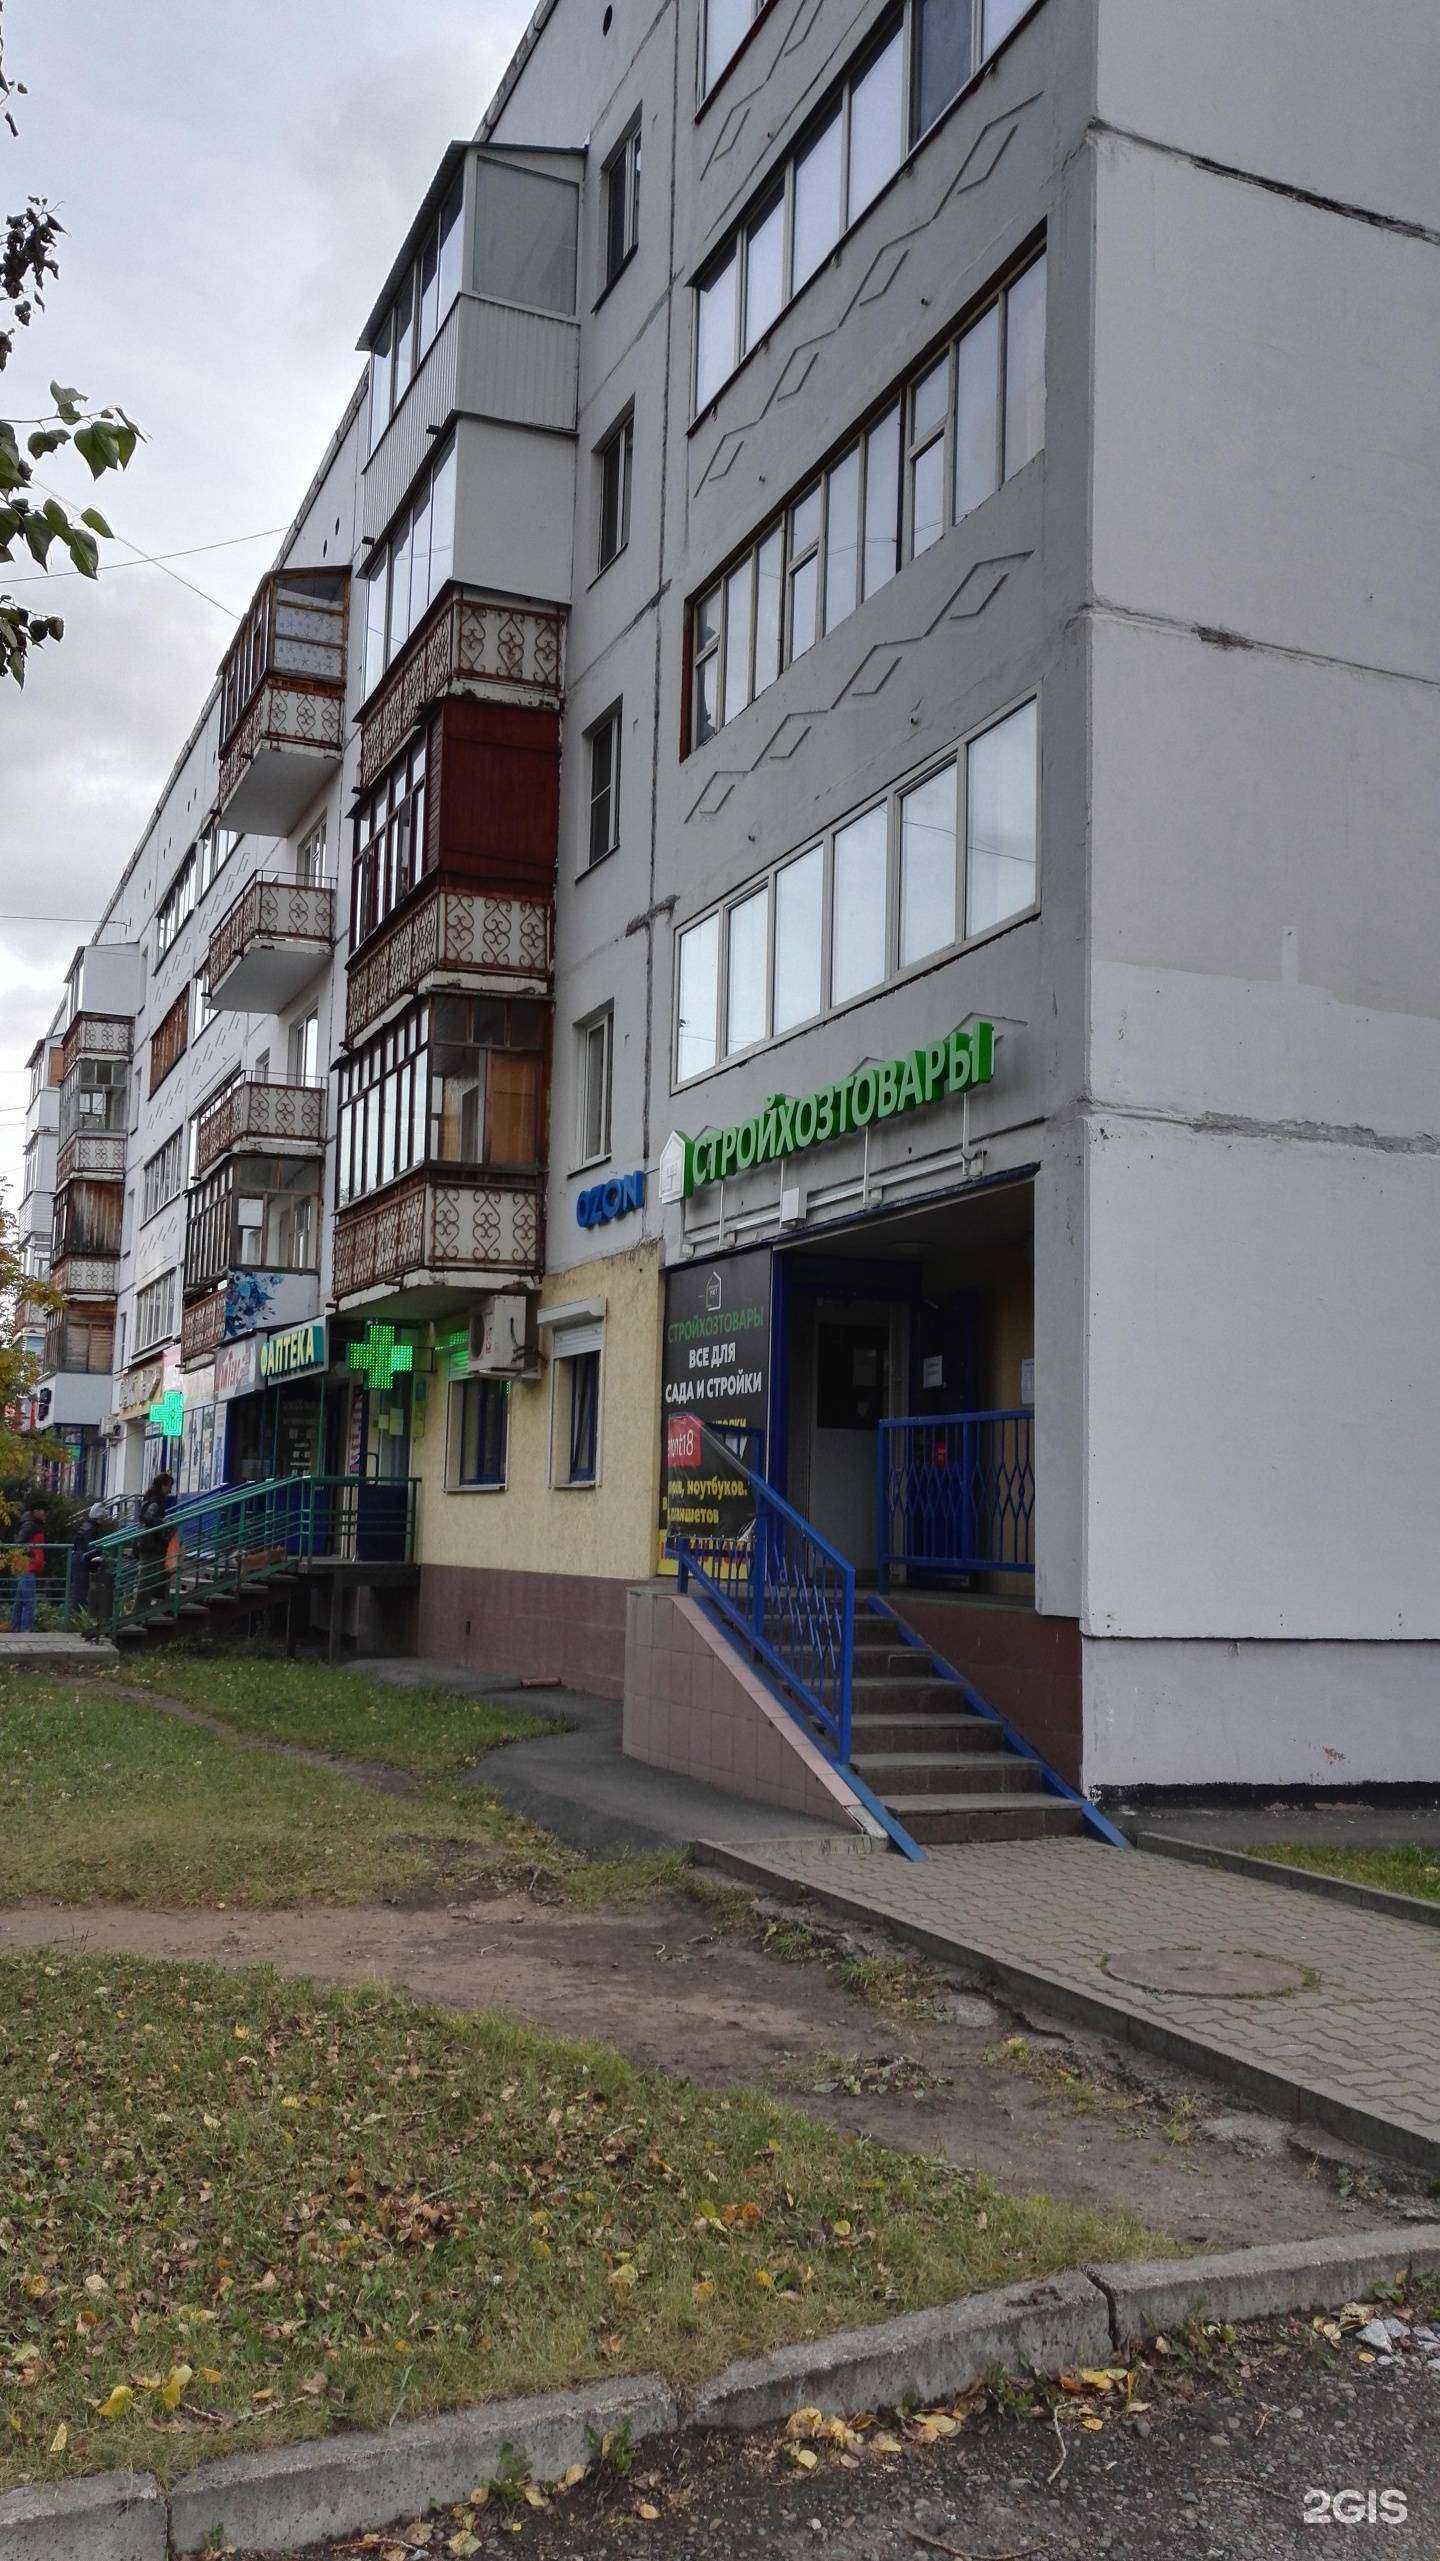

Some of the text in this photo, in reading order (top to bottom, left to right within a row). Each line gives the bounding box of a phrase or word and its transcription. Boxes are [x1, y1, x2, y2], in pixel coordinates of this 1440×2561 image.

[693, 1021, 994, 1187] СТРОЙХОЗТОВАРЫ
[576, 1170, 645, 1228] OZON
[668, 1306, 764, 1343] СТРОЙХОЗТОВАРЫ
[689, 1342, 735, 1369] ВСЕ ДЛЯ
[665, 1369, 761, 1404] САДА И СТРОЙКИ
